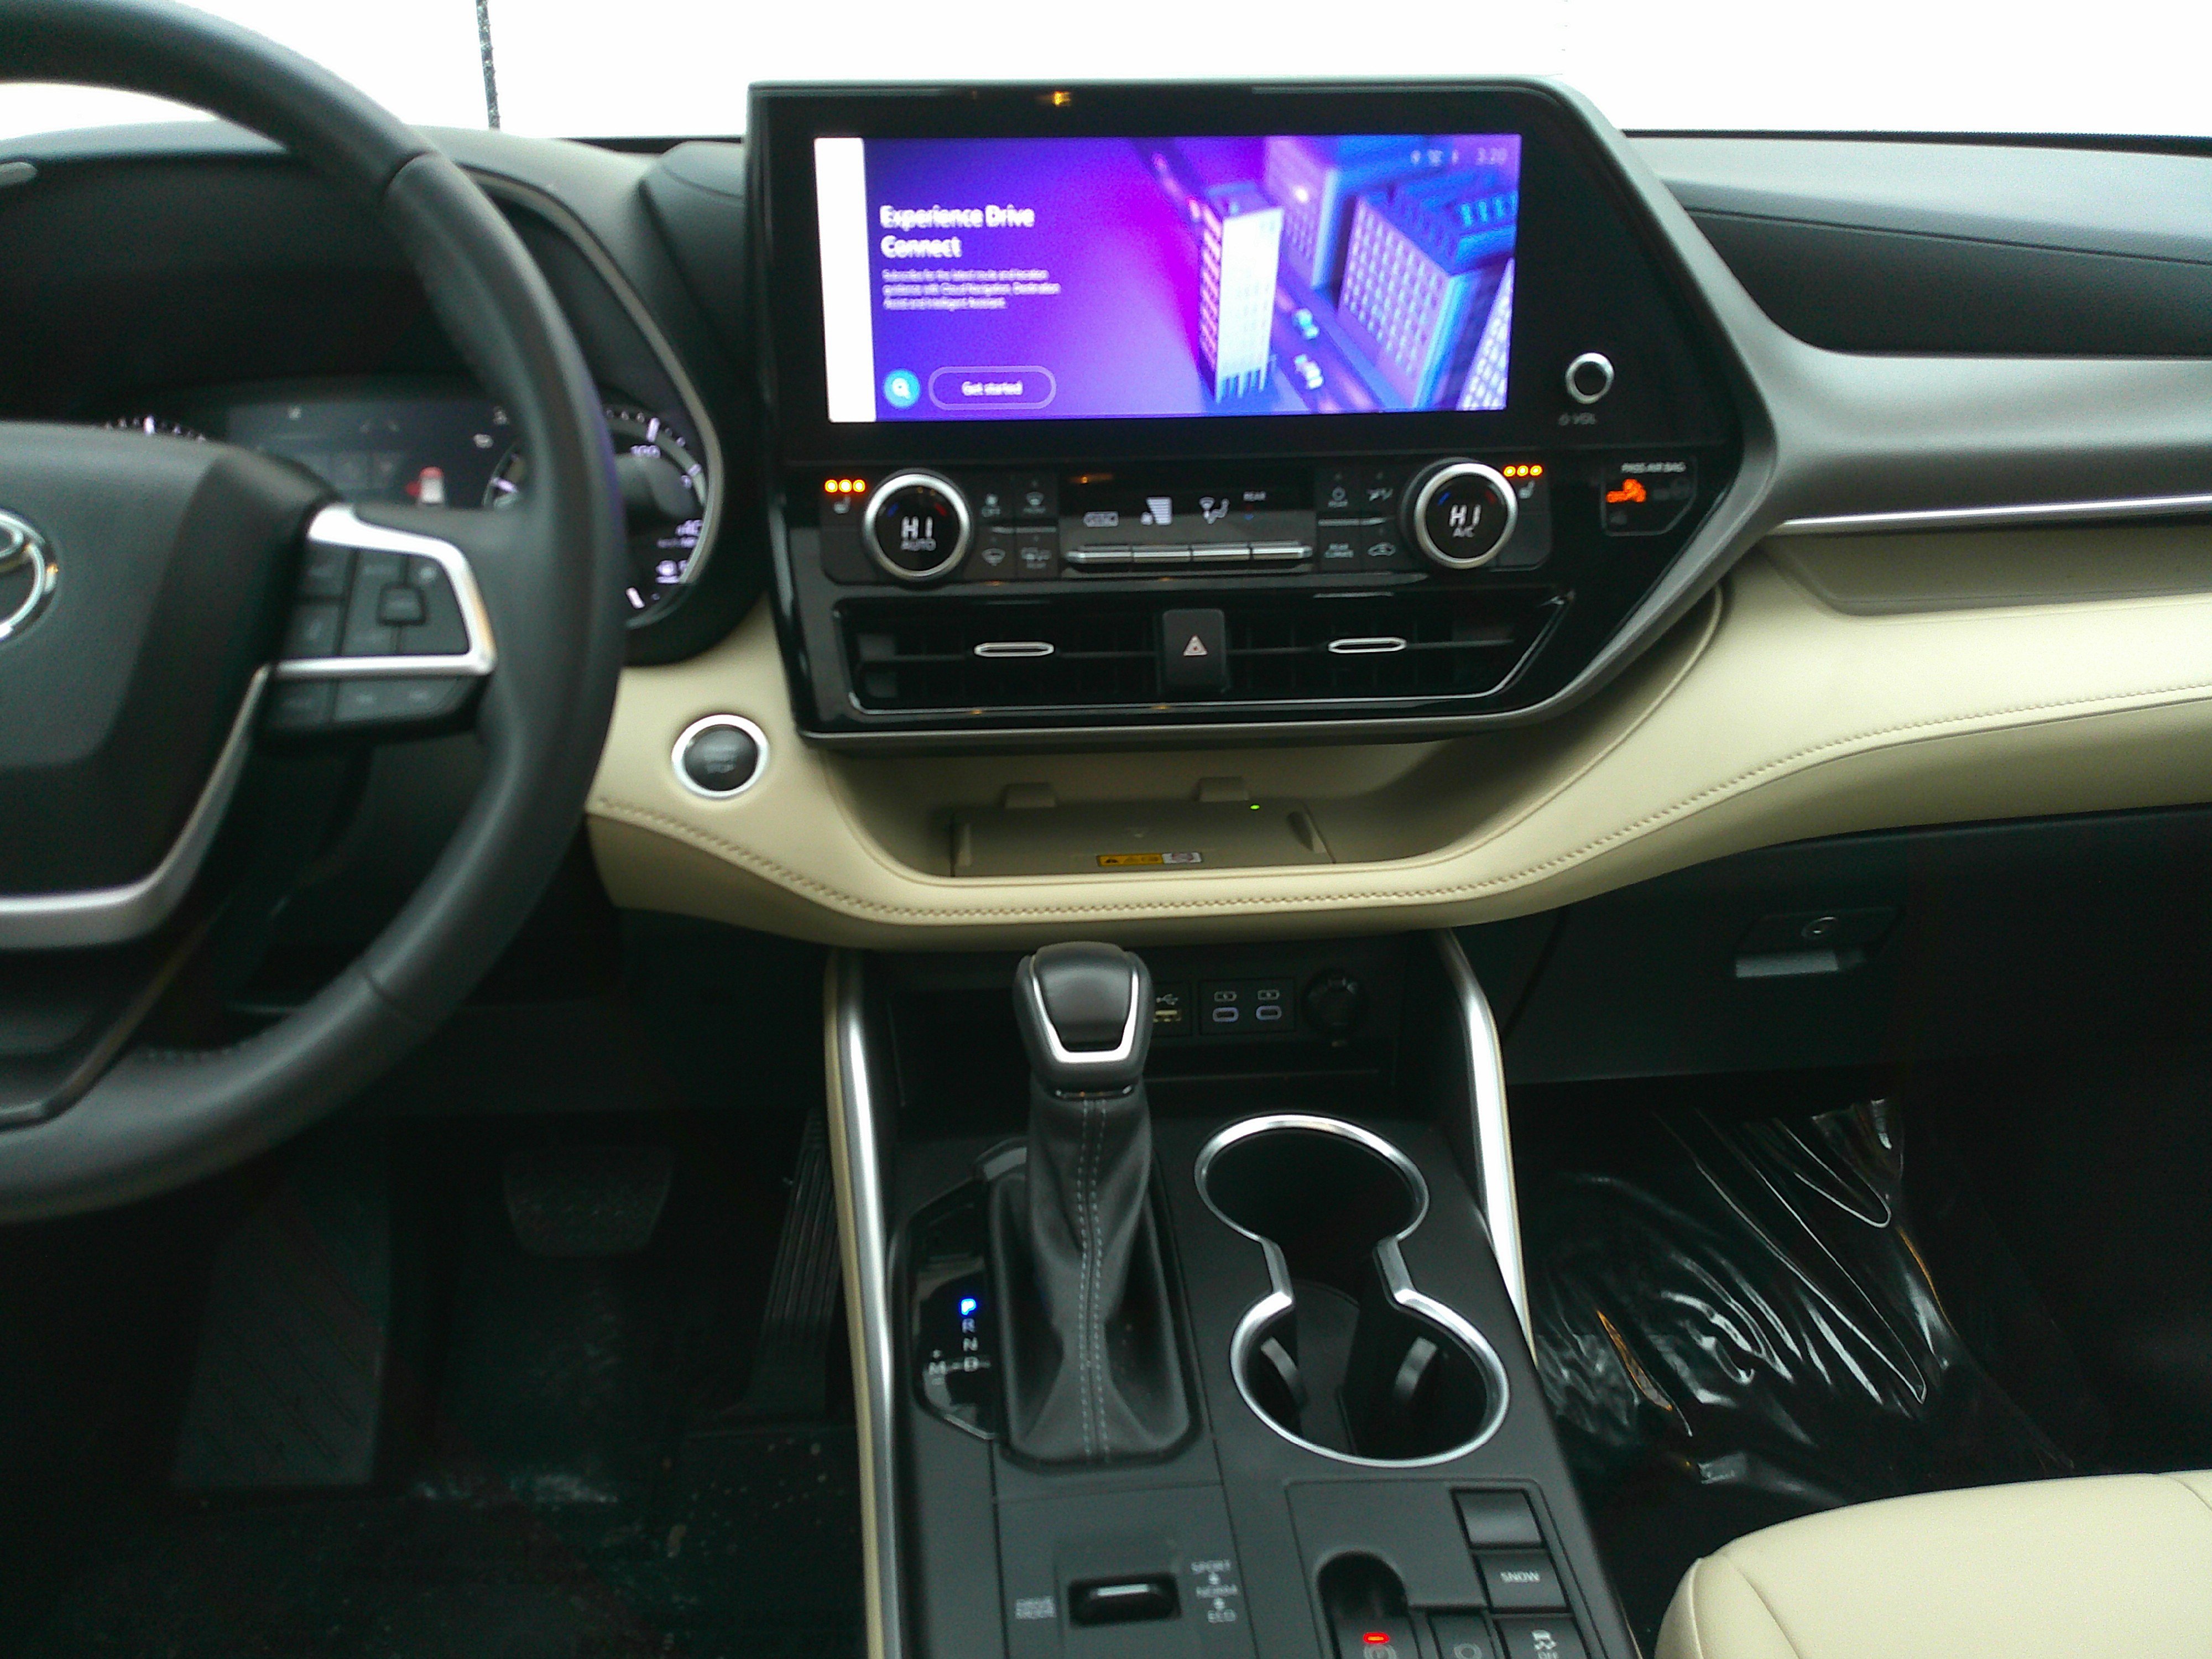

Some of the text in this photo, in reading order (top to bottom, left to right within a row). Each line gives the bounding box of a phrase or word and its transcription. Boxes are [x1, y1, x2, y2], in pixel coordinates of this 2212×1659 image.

[879, 203, 1035, 232] Experience Drive
[880, 234, 962, 259] Connect
[960, 1298, 977, 1316] P
[962, 1336, 978, 1351] N
[1500, 1571, 1541, 1583] SNOW
